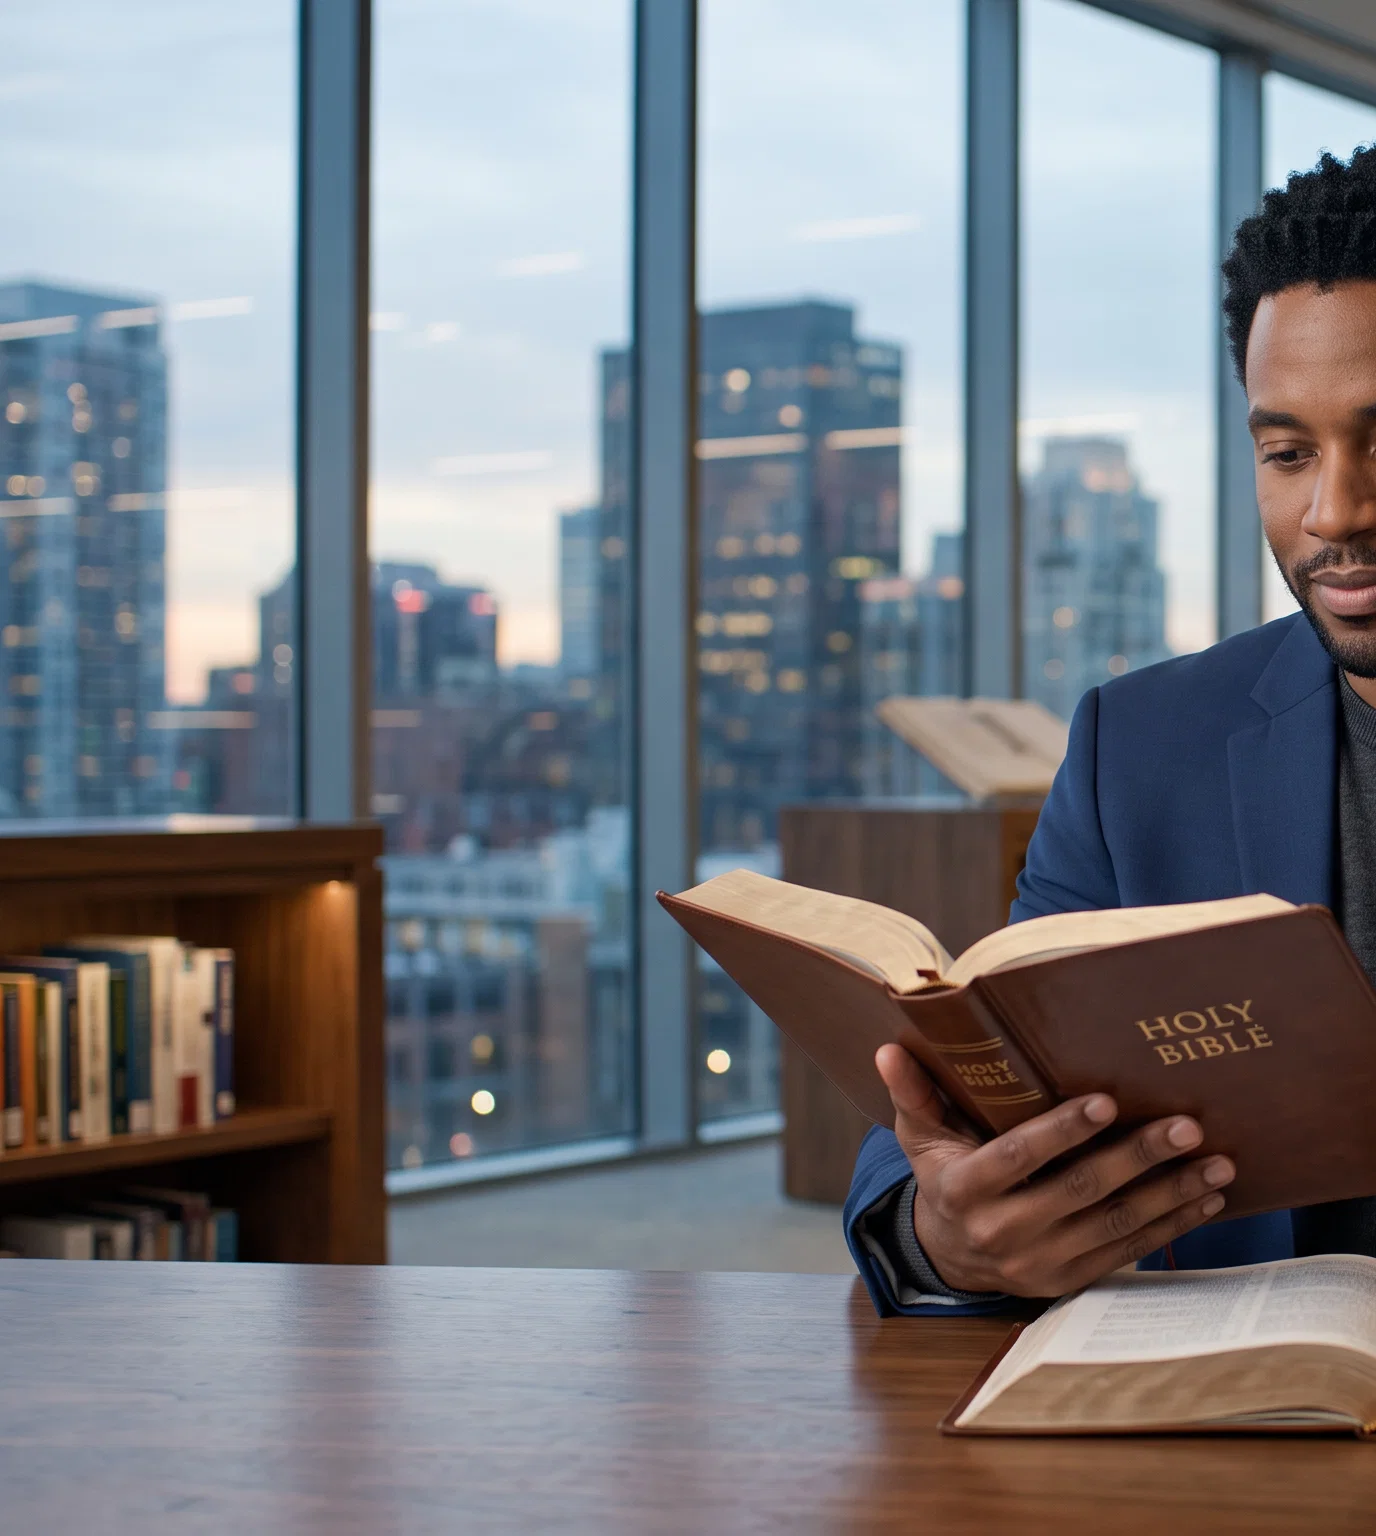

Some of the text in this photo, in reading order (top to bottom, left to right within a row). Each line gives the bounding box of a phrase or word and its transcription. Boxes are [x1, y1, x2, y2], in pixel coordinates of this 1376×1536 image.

[1135, 999, 1253, 1041] HOLY
[1153, 1024, 1274, 1066] BIBLE
[954, 1059, 1010, 1075] HOLY
[963, 1071, 1020, 1087] BIBLE
